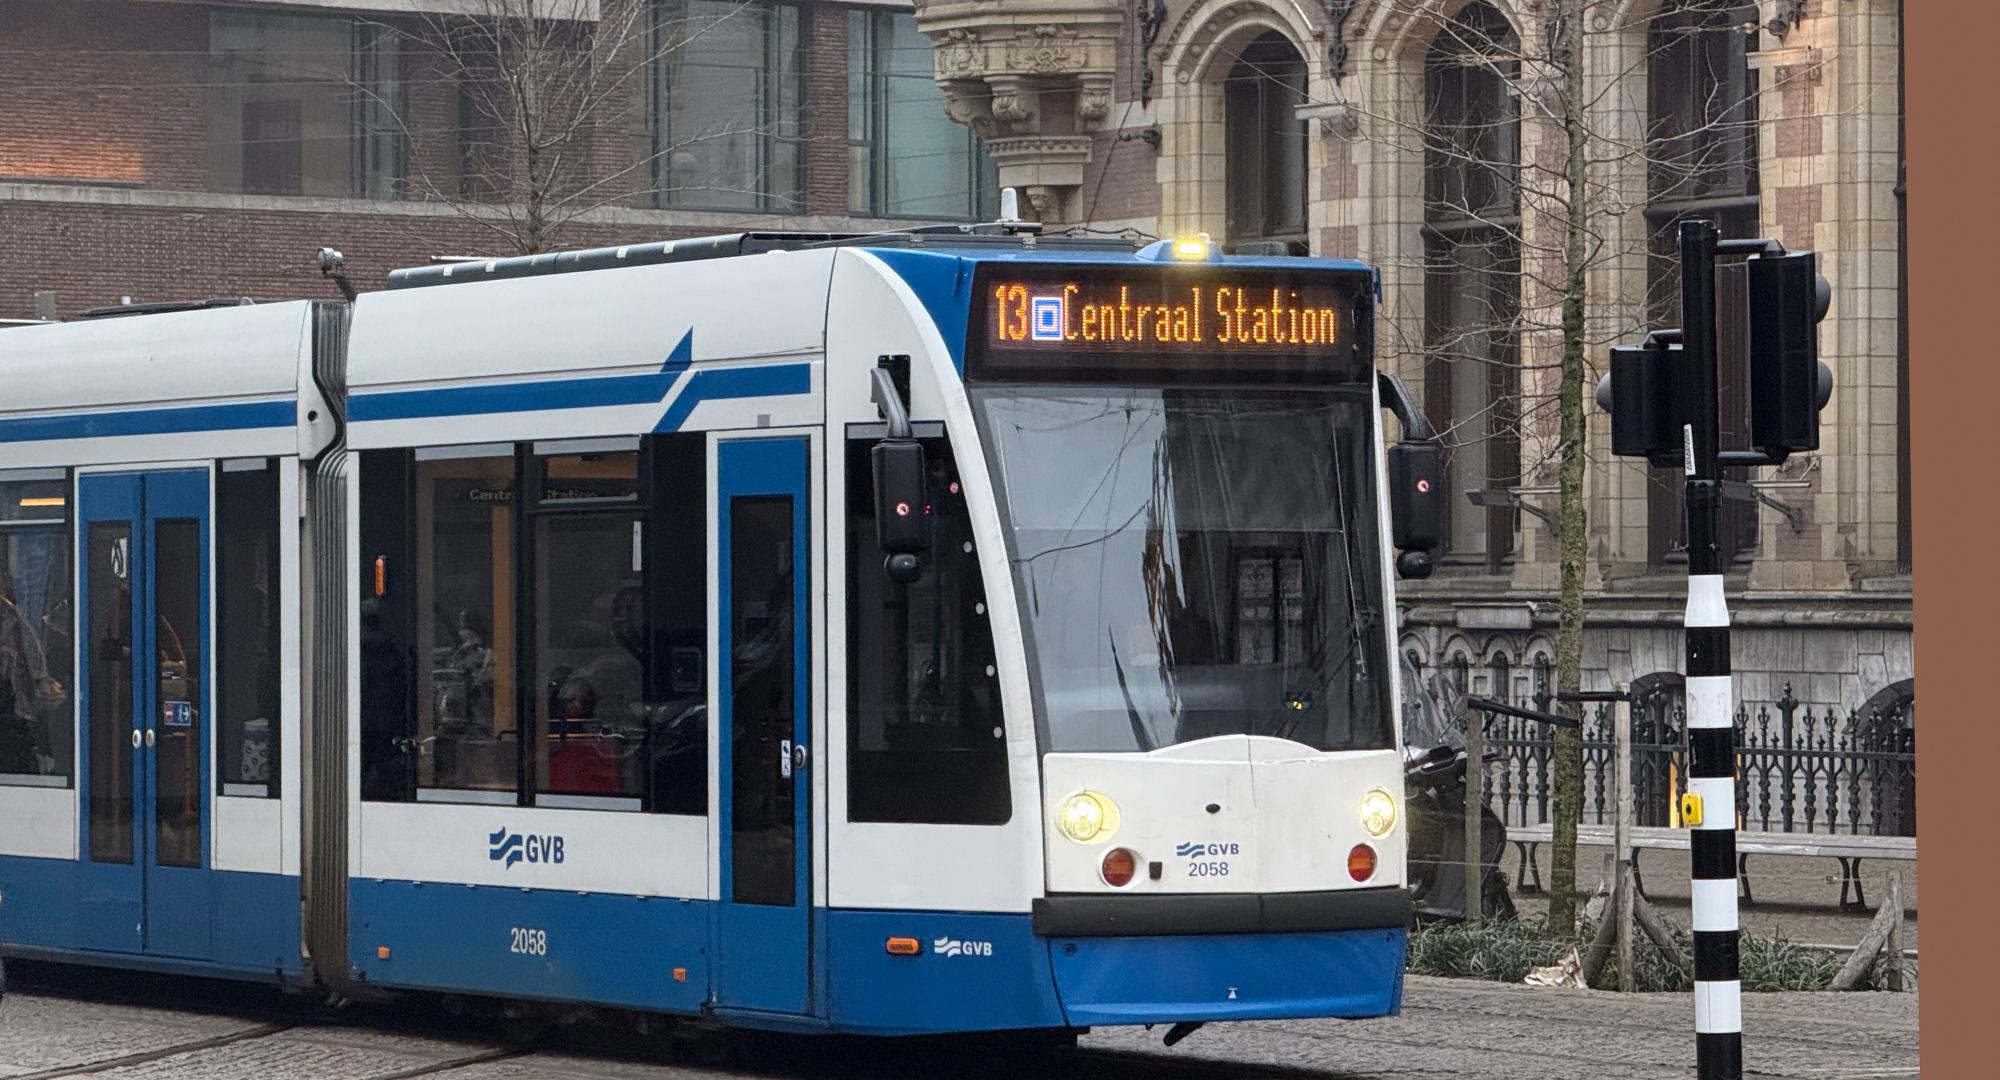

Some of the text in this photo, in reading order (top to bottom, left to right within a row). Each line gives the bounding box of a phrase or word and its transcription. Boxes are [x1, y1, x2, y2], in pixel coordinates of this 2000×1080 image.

[995, 285, 1336, 344] 13 Centraal Station
[525, 834, 565, 864] GVB
[1207, 843, 1240, 856] GVB
[1188, 861, 1229, 877] 2058
[510, 927, 546, 956] 2058
[962, 940, 993, 957] GVB
